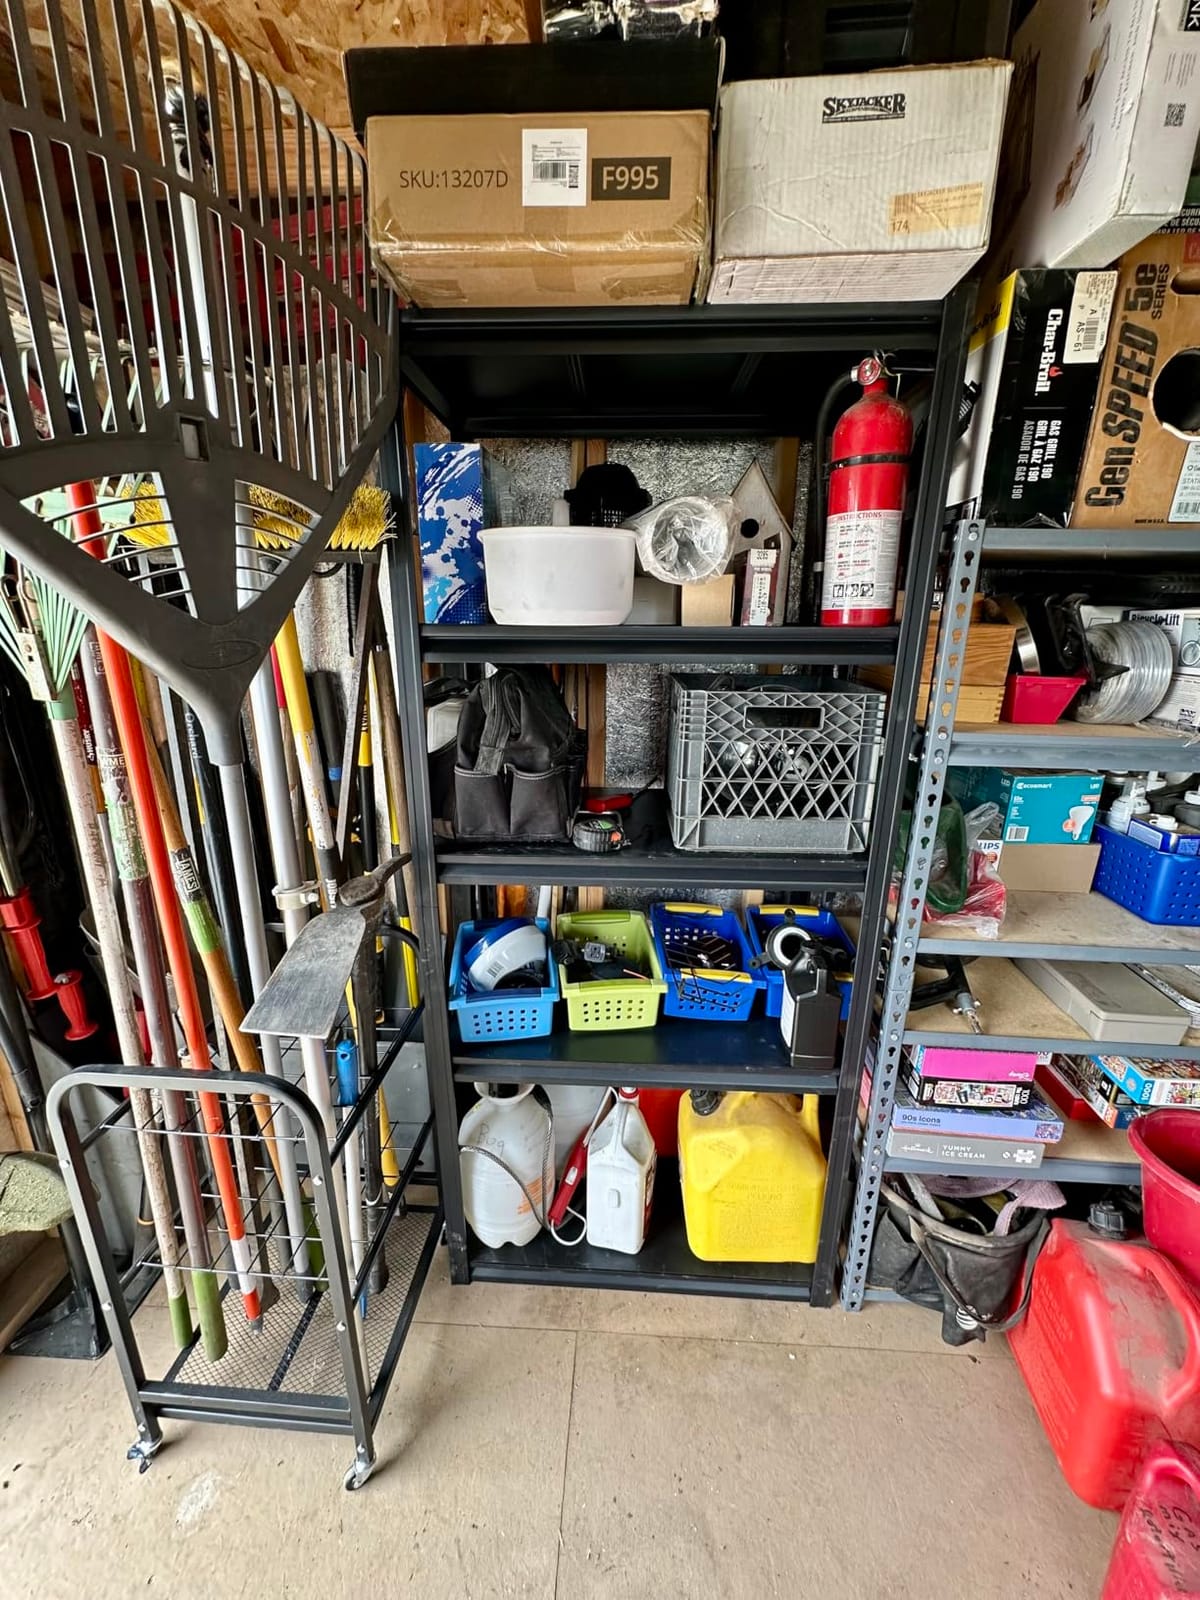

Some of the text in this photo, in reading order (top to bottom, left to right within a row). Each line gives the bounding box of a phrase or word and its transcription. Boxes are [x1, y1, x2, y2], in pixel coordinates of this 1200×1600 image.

[823, 93, 907, 117] SKYJACKER
[399, 169, 509, 189] SKU:13207D
[602, 164, 659, 191] F995
[1151, 263, 1171, 320] SERIES
[1035, 308, 1064, 393] Char-Broil
[1034, 420, 1049, 439] GRIL
[1030, 448, 1044, 464] GAZ
[1040, 420, 1062, 479] GAS GRILL 190
[1011, 420, 1035, 499] ASADOR DE GAS 190
[1026, 466, 1040, 482] 190
[837, 511, 882, 521] INSTCTIONS
[1164, 614, 1180, 626] Lift
[185, 712, 203, 760] Orchard
[1141, 1082, 1153, 1101] 1000
[942, 1144, 972, 1152] YUMMY
[957, 1151, 985, 1159] CREAM
